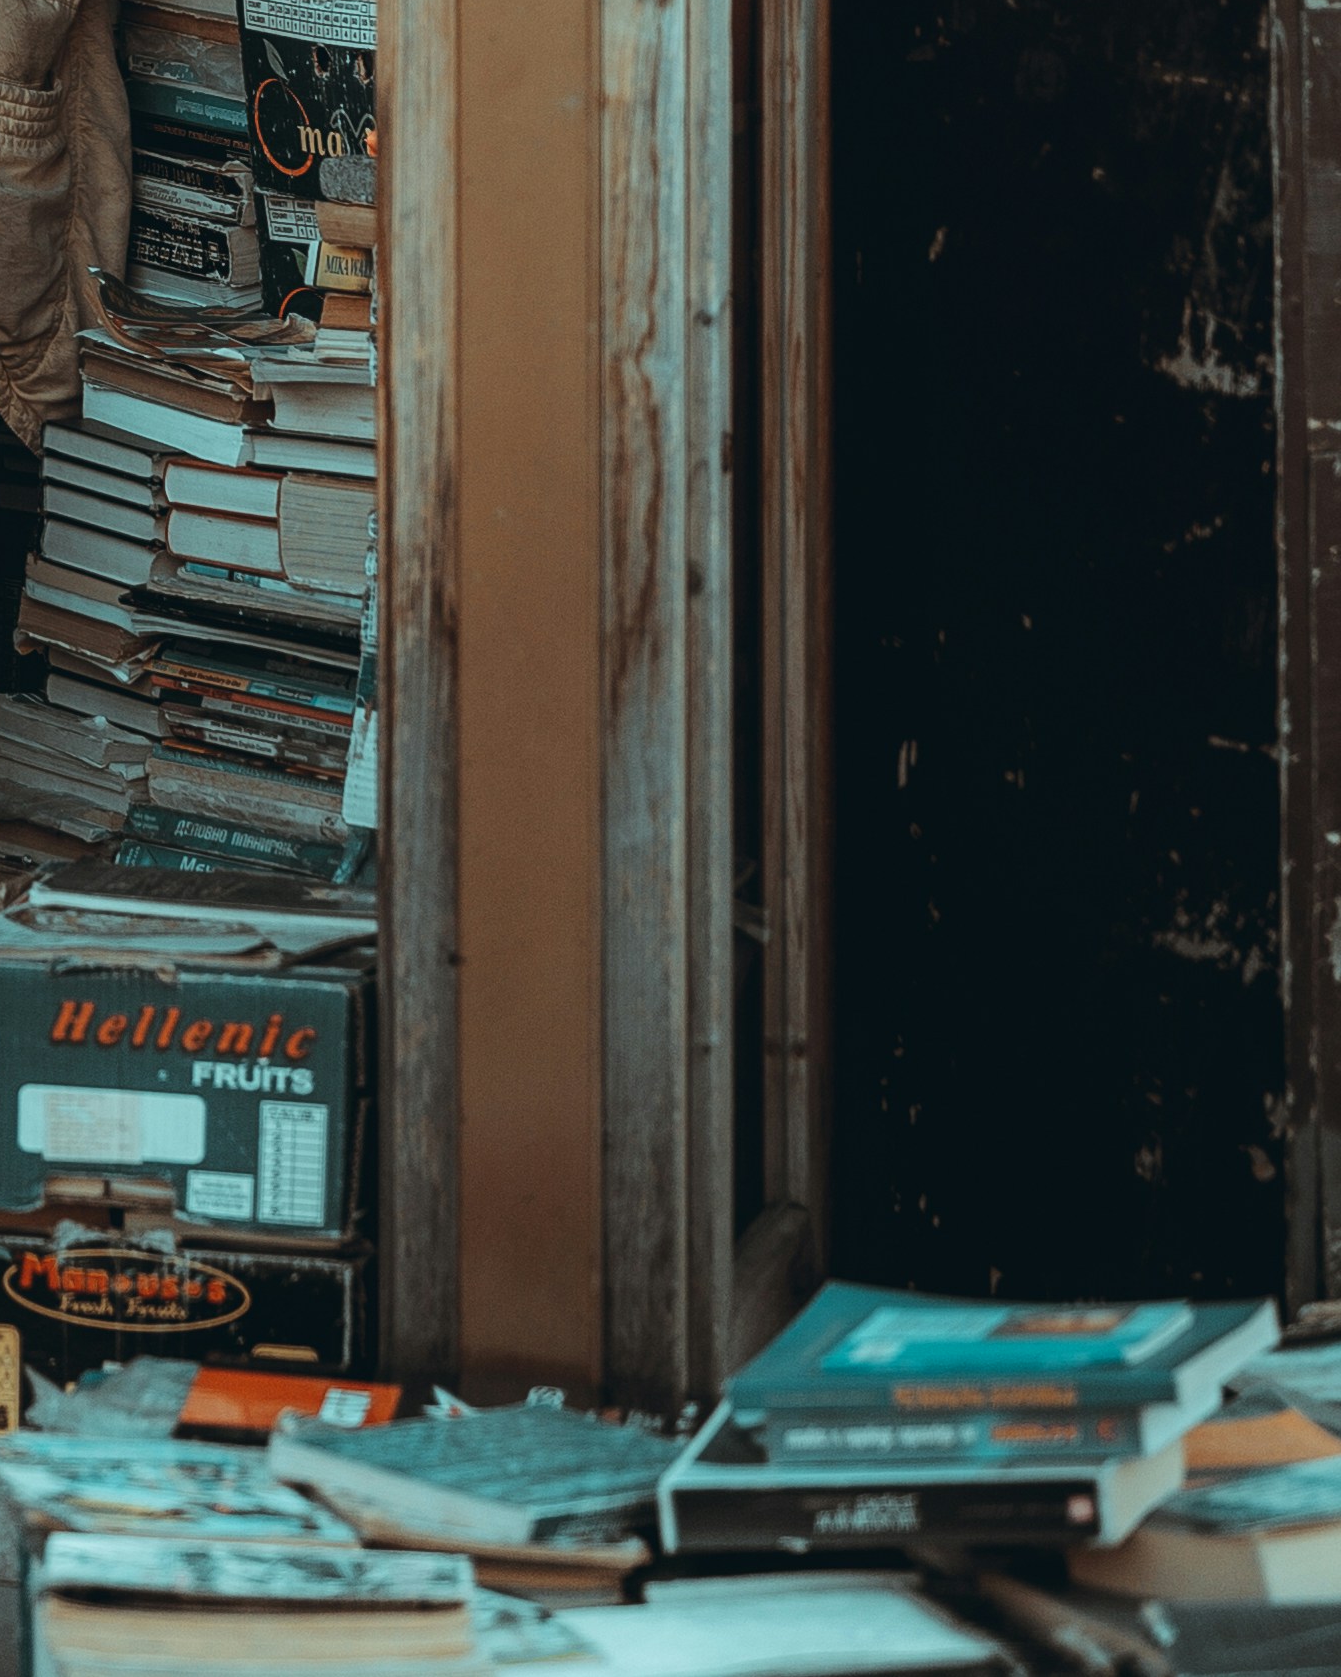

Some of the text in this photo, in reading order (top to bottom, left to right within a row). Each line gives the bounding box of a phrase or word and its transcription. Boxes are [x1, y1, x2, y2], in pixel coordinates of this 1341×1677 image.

[174, 819, 228, 843] ДЕЛОВНО
[50, 1000, 317, 1060] Hellenic
[192, 1058, 315, 1095] FRUITS
